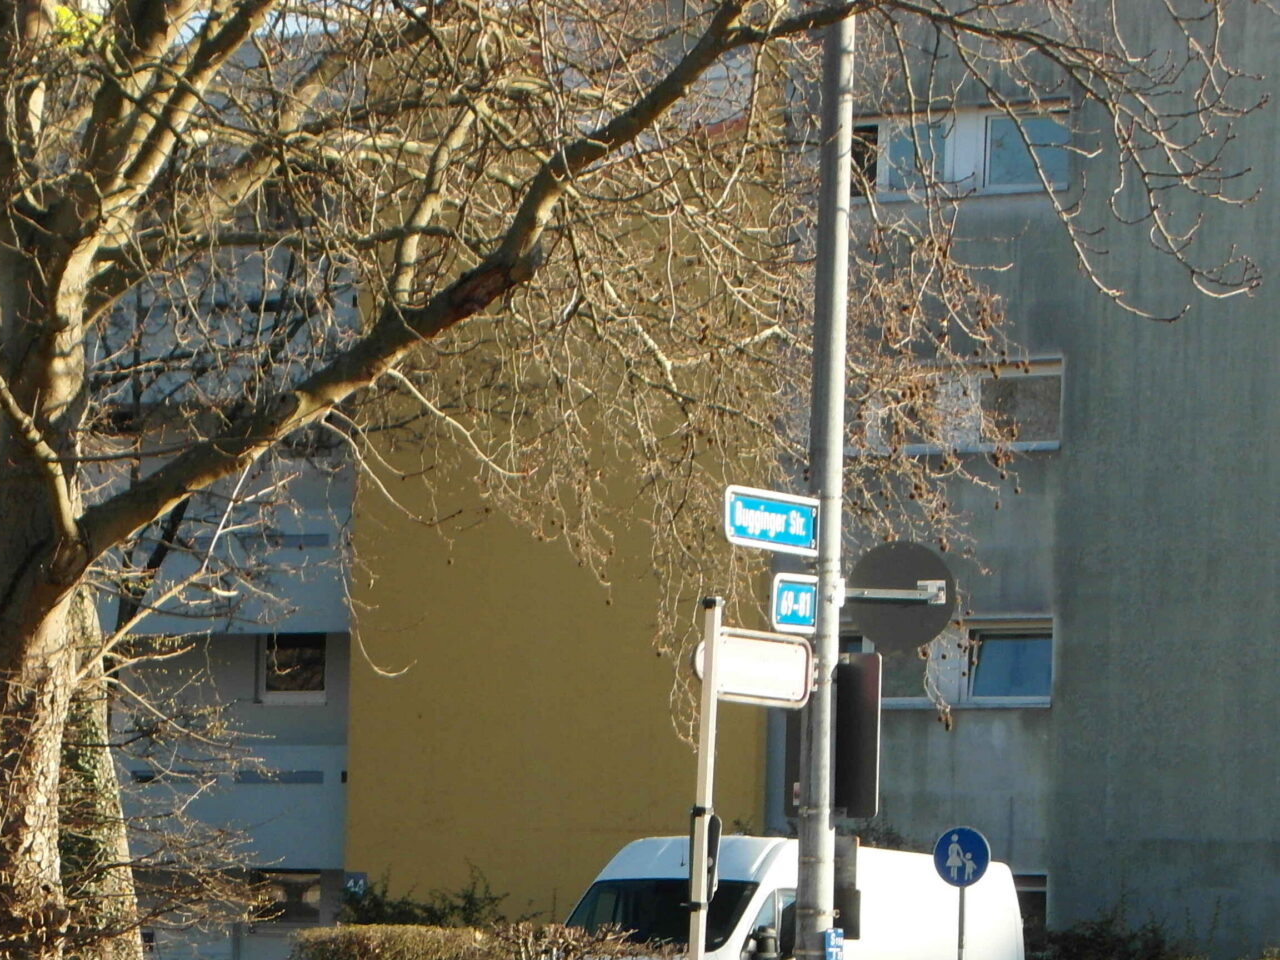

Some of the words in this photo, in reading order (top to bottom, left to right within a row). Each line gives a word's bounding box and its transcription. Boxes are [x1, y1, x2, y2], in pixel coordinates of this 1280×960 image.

[734, 500, 787, 538] Bugginger
[789, 510, 807, 536] Str.
[780, 590, 812, 618] 69-81
